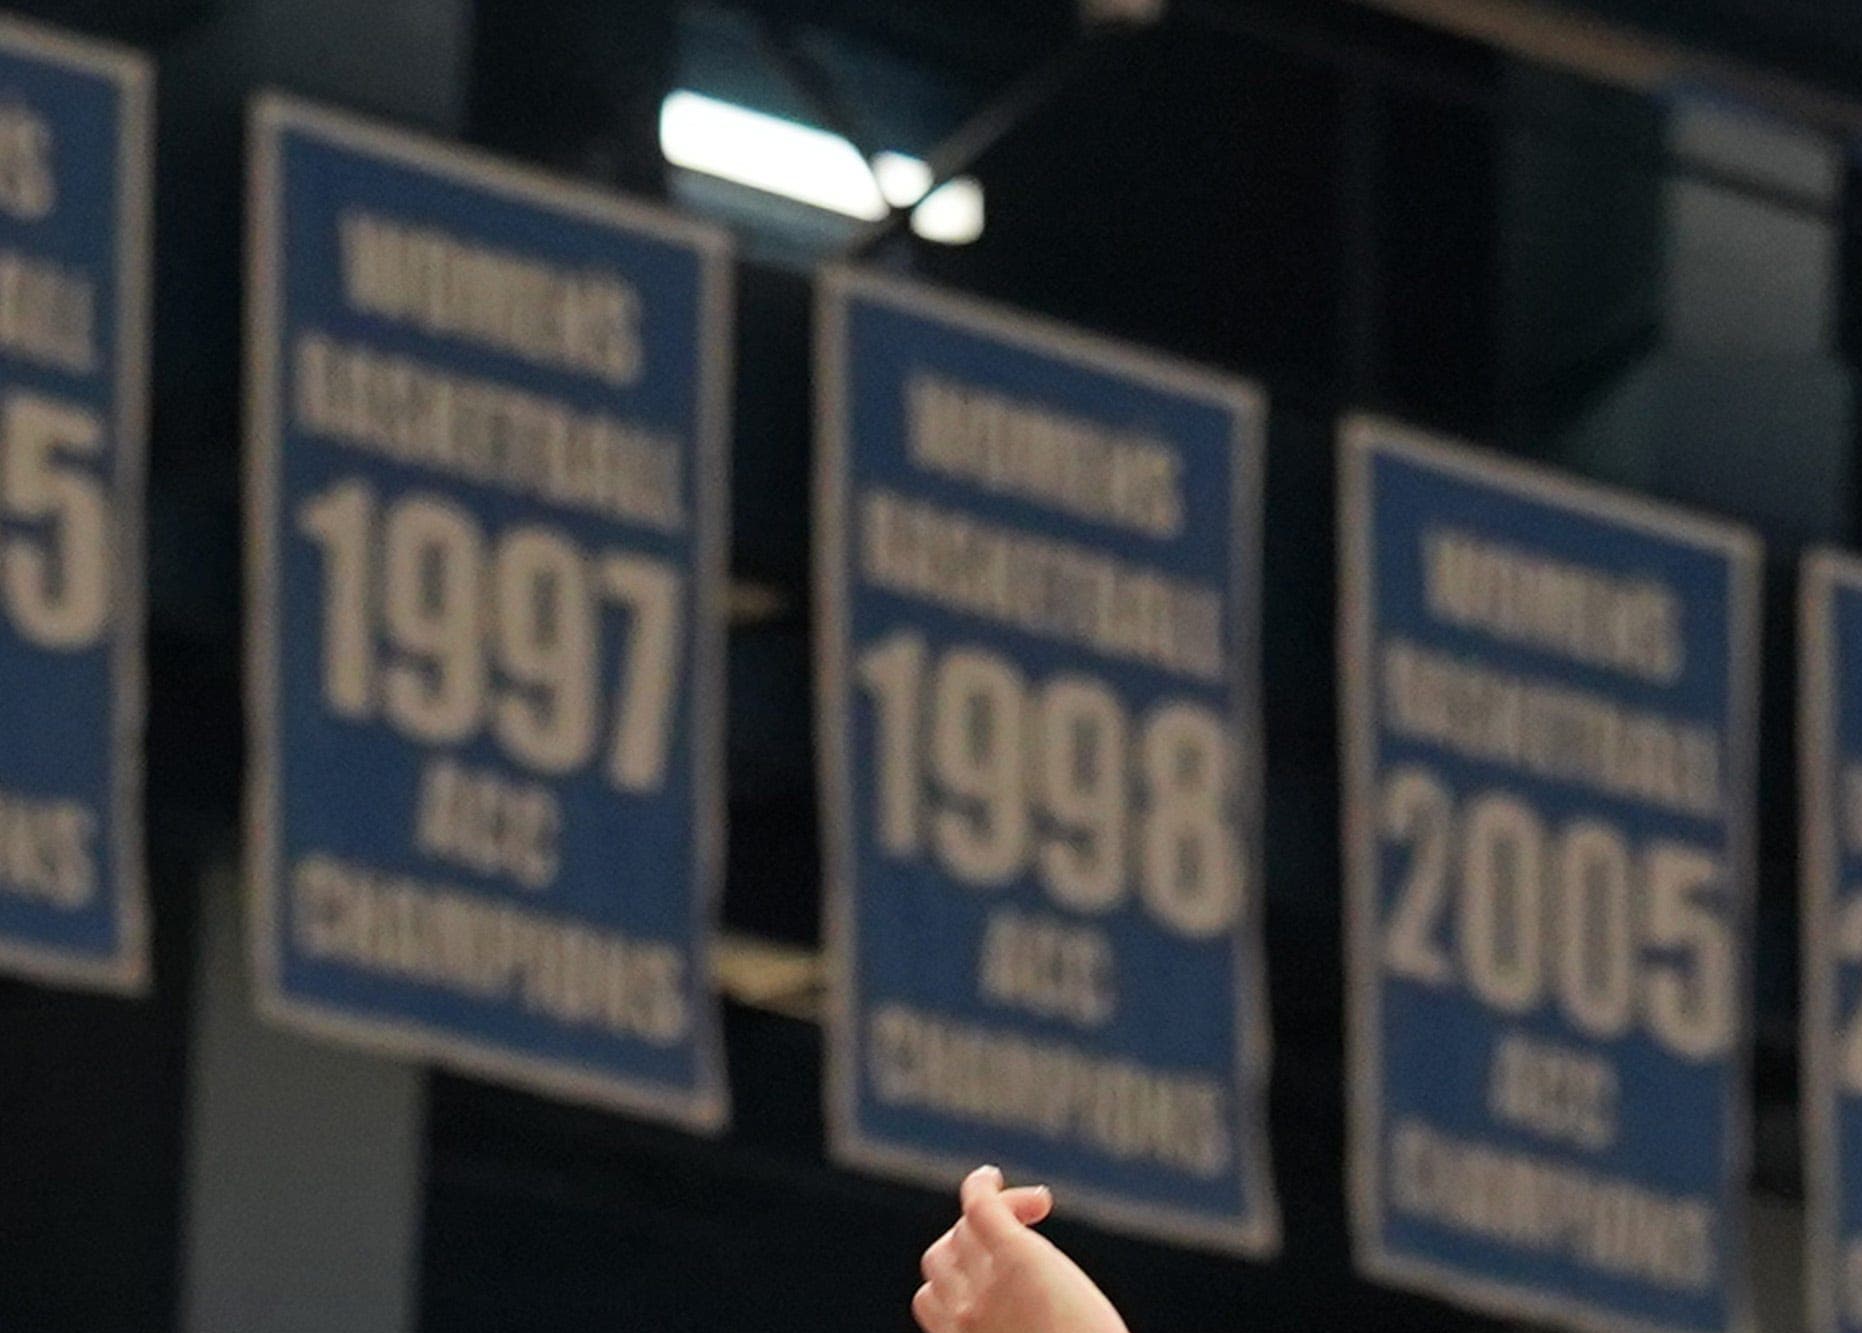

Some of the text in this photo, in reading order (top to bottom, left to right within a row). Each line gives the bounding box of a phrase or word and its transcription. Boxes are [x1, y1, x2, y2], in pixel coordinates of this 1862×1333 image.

[299, 480, 680, 790] 1997
[418, 758, 558, 886] ACC
[858, 633, 1238, 934] 1998
[293, 856, 685, 1044] CHAMPIONS
[984, 908, 1113, 1022] ACC
[1383, 769, 1732, 1056] 2005
[874, 1006, 1224, 1174] CHAMPIONS
[1491, 1036, 1615, 1147] ACC
[1396, 1122, 1712, 1290] CHAMPIONS
